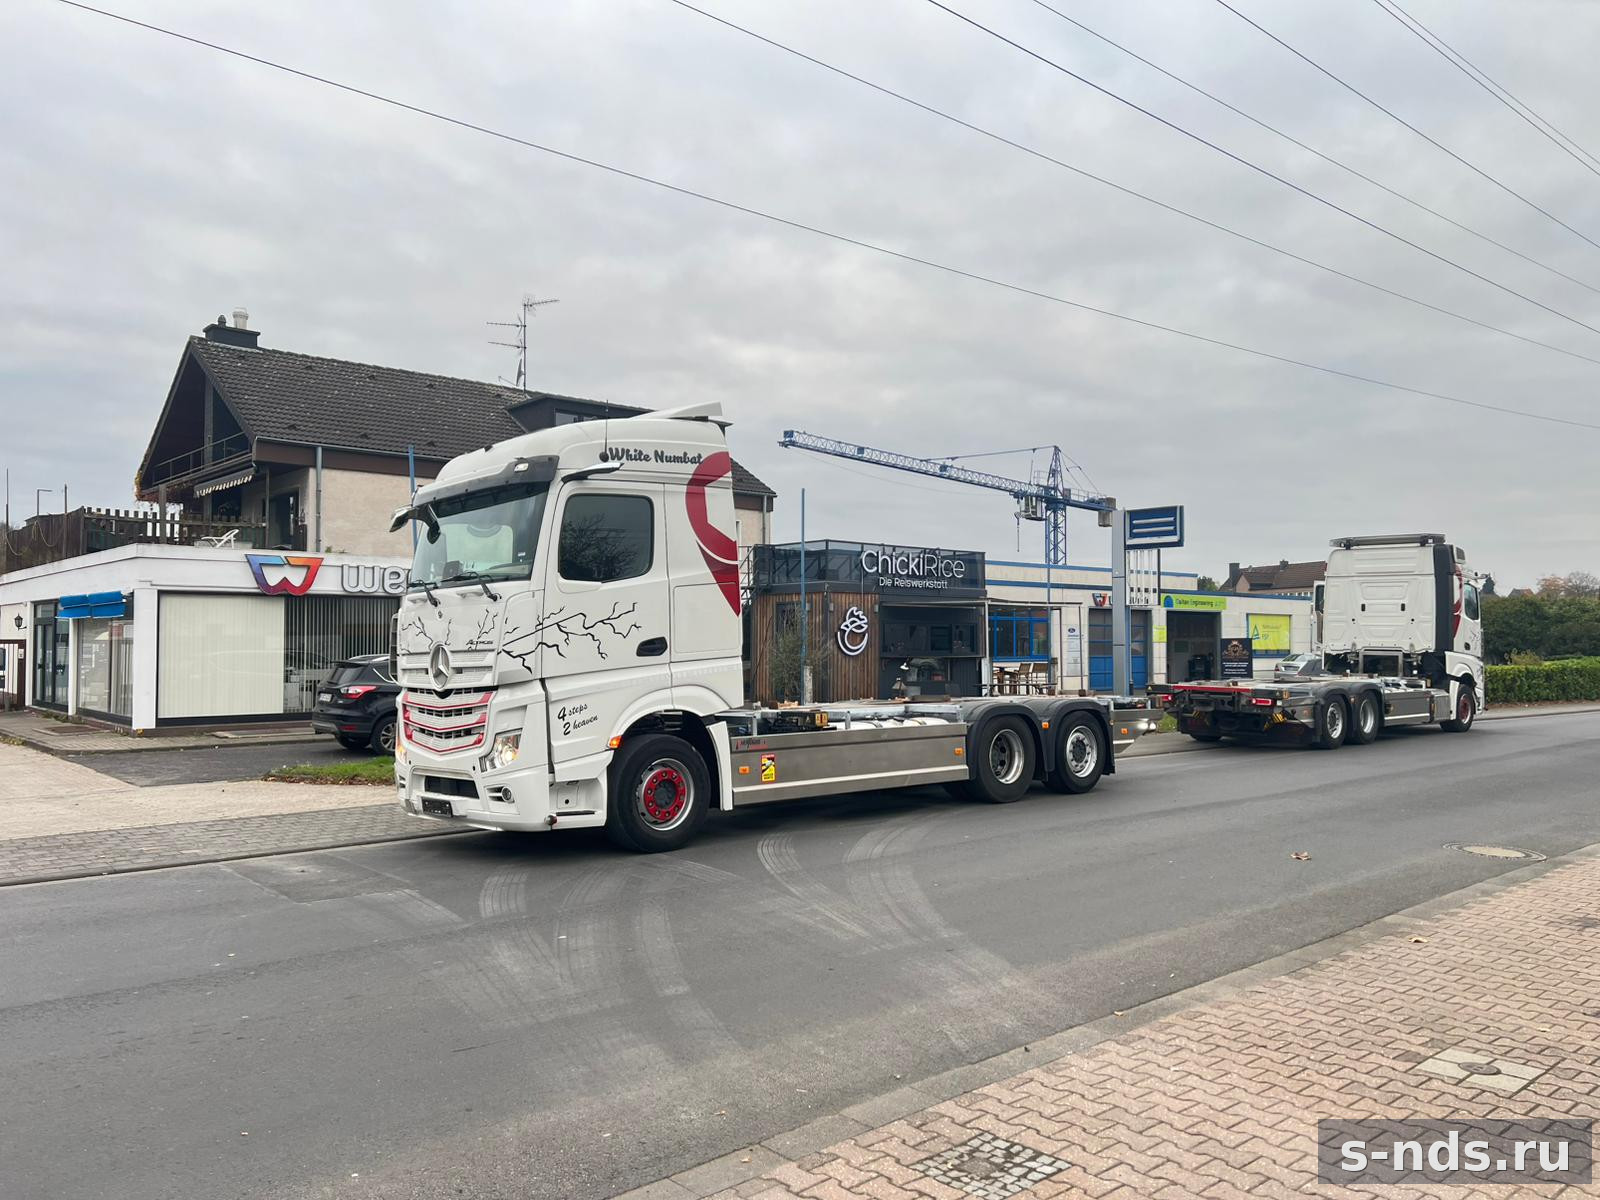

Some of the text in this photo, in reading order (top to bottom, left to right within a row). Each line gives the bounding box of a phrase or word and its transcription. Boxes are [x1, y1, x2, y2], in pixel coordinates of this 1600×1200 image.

[608, 447, 704, 465] White Numbat
[862, 550, 965, 578] ChickiRice
[341, 564, 411, 595] we
[879, 577, 948, 589] Die Reiswerkstatt
[557, 703, 588, 721] 4 steps
[563, 715, 598, 736] 2 heaven
